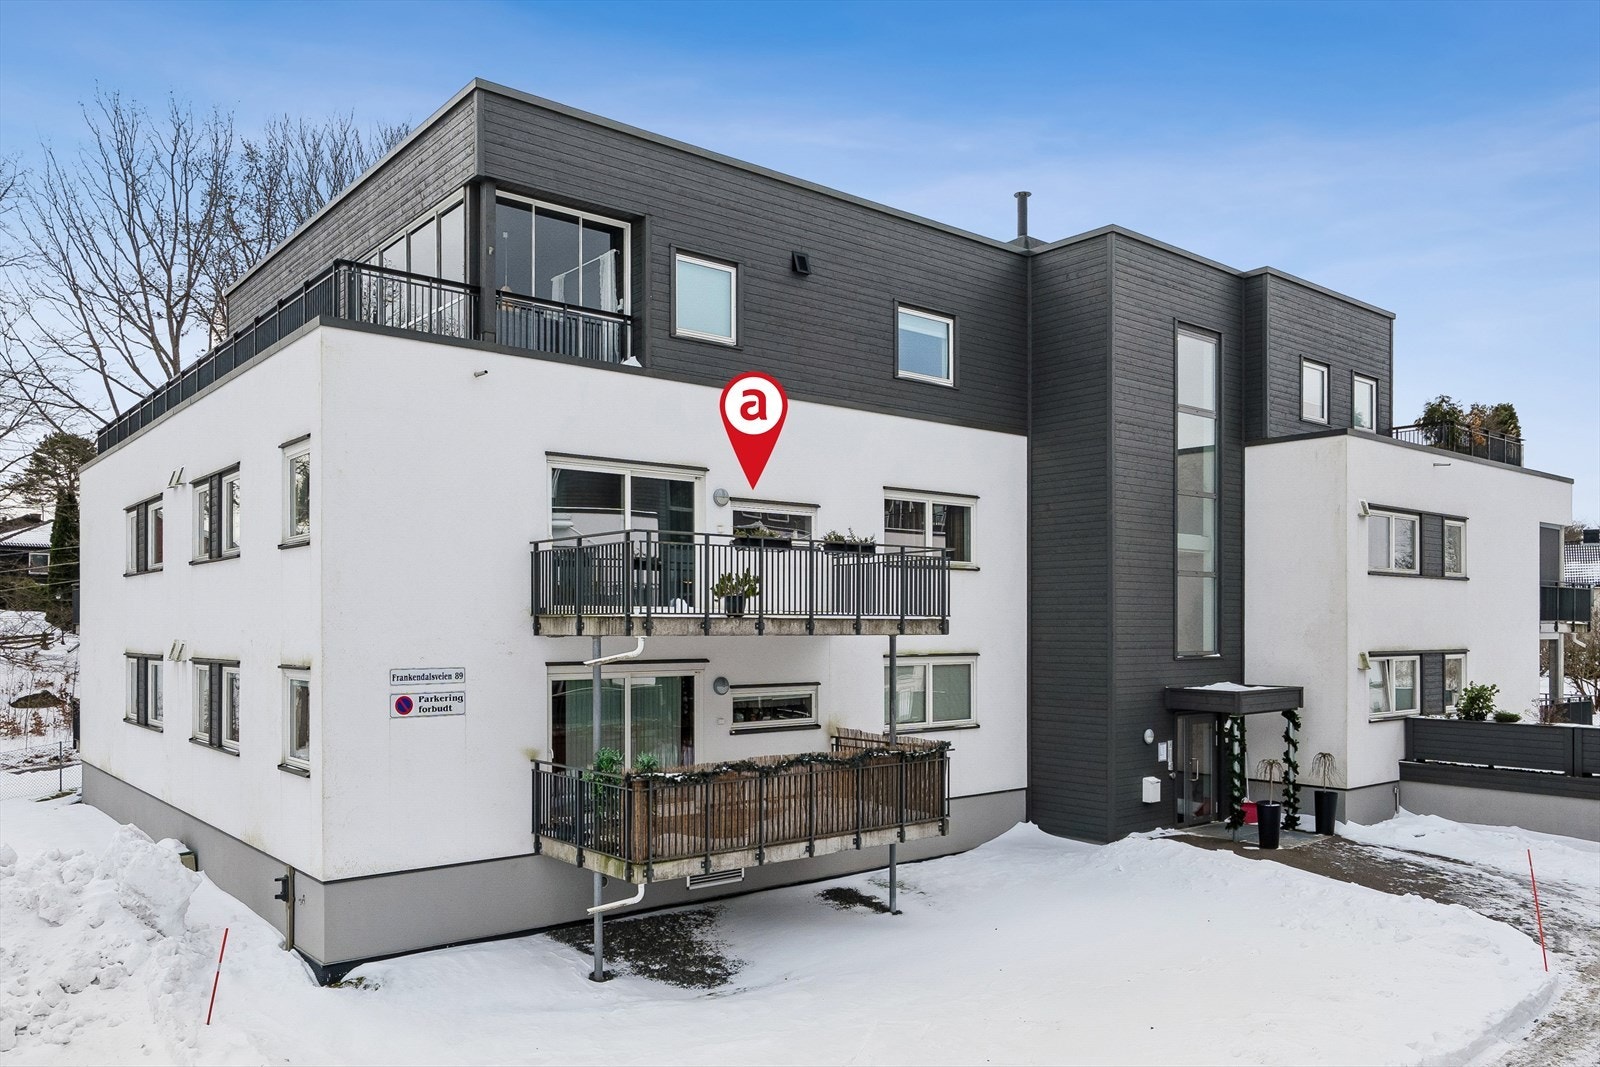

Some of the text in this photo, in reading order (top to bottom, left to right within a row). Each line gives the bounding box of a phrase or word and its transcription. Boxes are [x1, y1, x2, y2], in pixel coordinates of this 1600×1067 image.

[392, 672, 464, 682] Frankendalsveien 89
[418, 694, 464, 703] Parkering
[418, 704, 453, 713] forbudt
